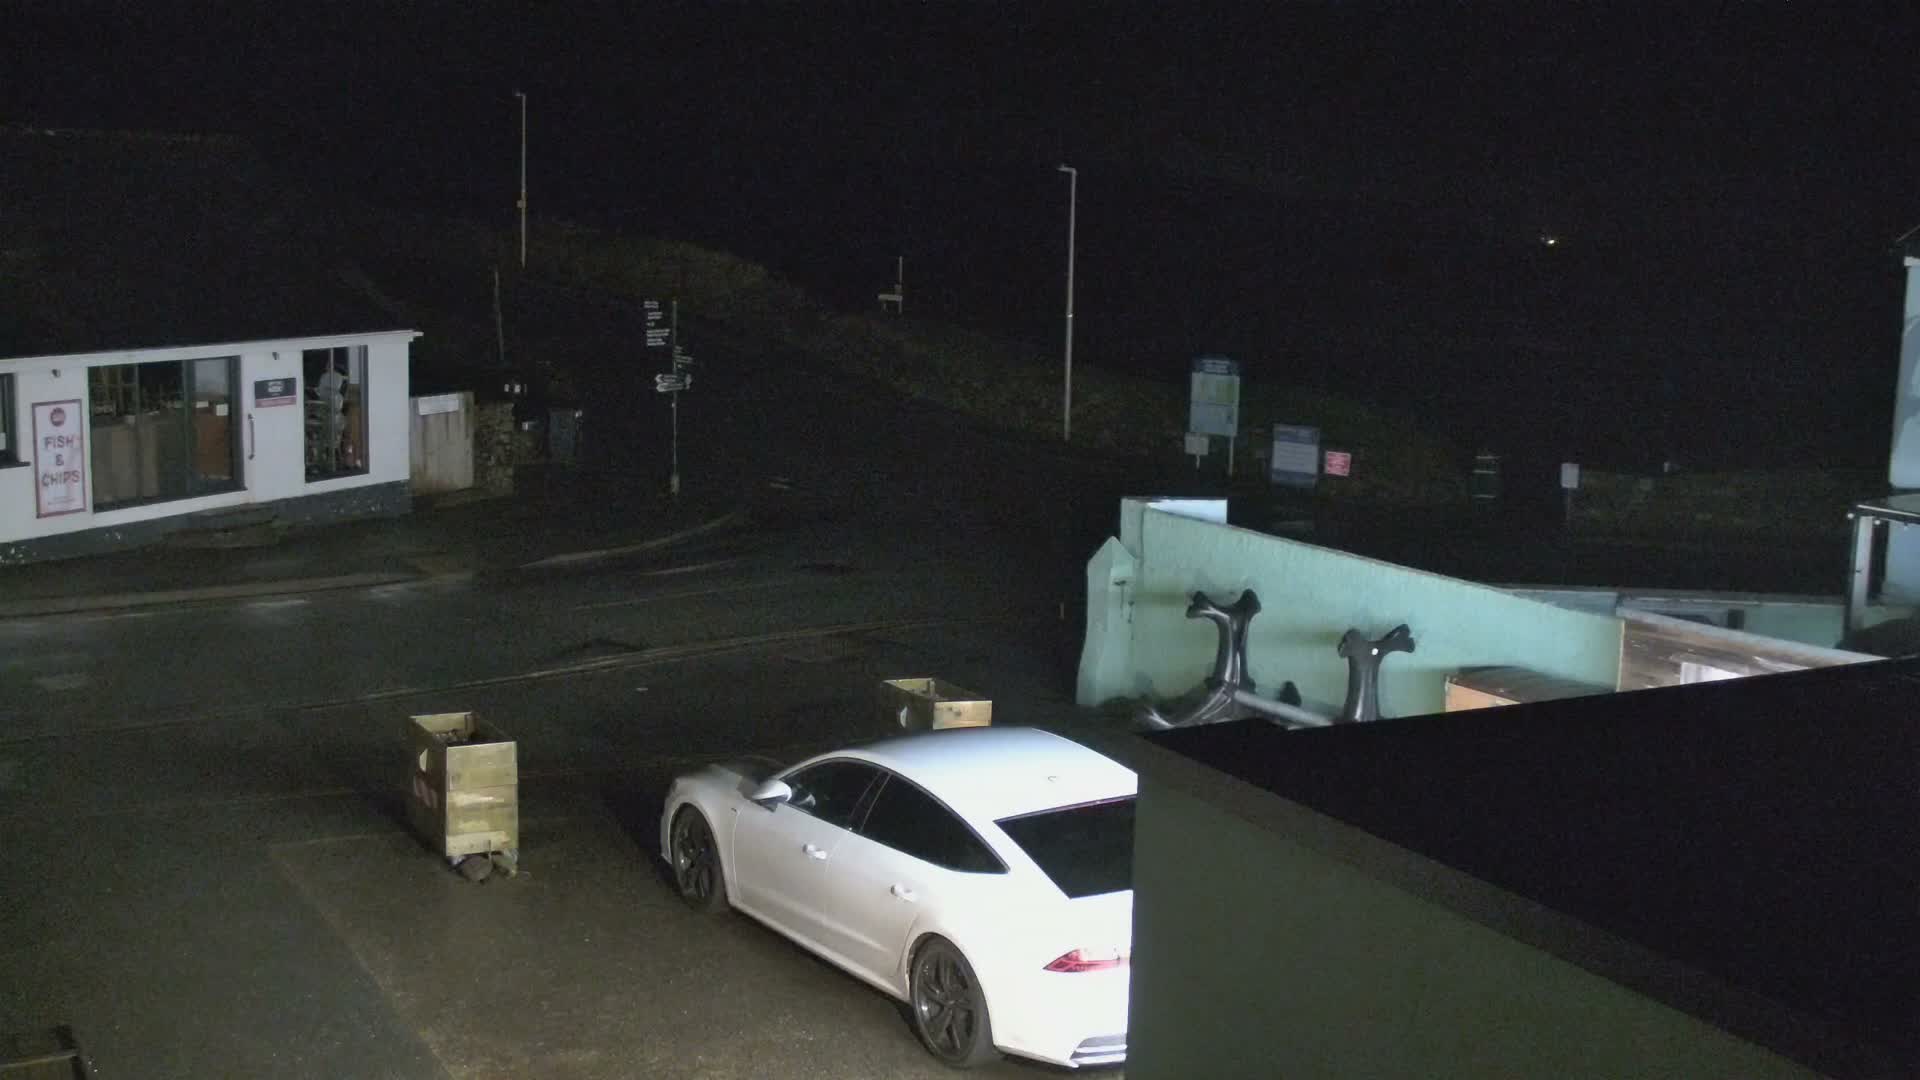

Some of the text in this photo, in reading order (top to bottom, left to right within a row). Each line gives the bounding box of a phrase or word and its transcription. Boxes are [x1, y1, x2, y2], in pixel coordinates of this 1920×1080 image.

[44, 435, 74, 449] FISH
[55, 454, 64, 466] &
[42, 470, 80, 487] CHIPS
